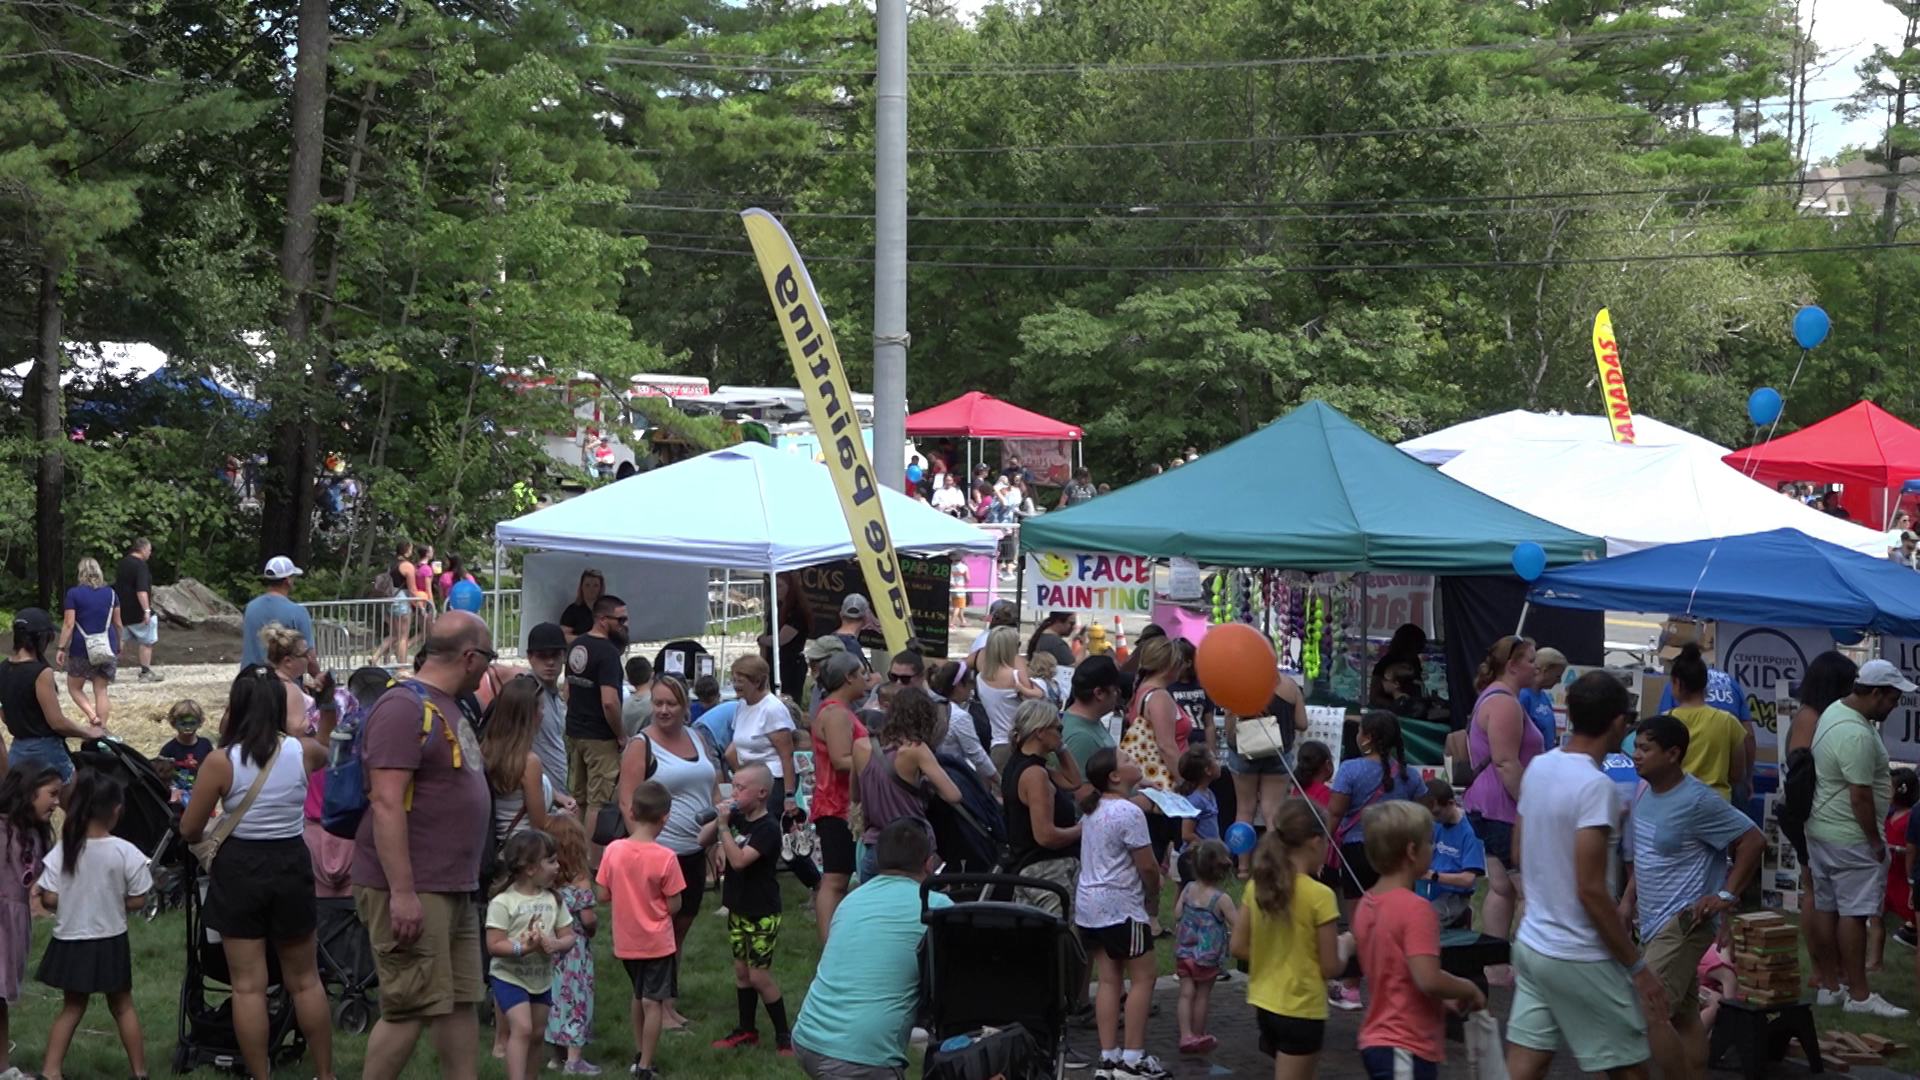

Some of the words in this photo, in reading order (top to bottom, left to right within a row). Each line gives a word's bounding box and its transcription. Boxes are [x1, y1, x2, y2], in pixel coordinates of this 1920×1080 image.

[932, 562, 949, 578] 28
[1075, 553, 1150, 584] FACE
[1036, 584, 1150, 611] PAINTING
[1734, 653, 1798, 666] CENTERPOINT
